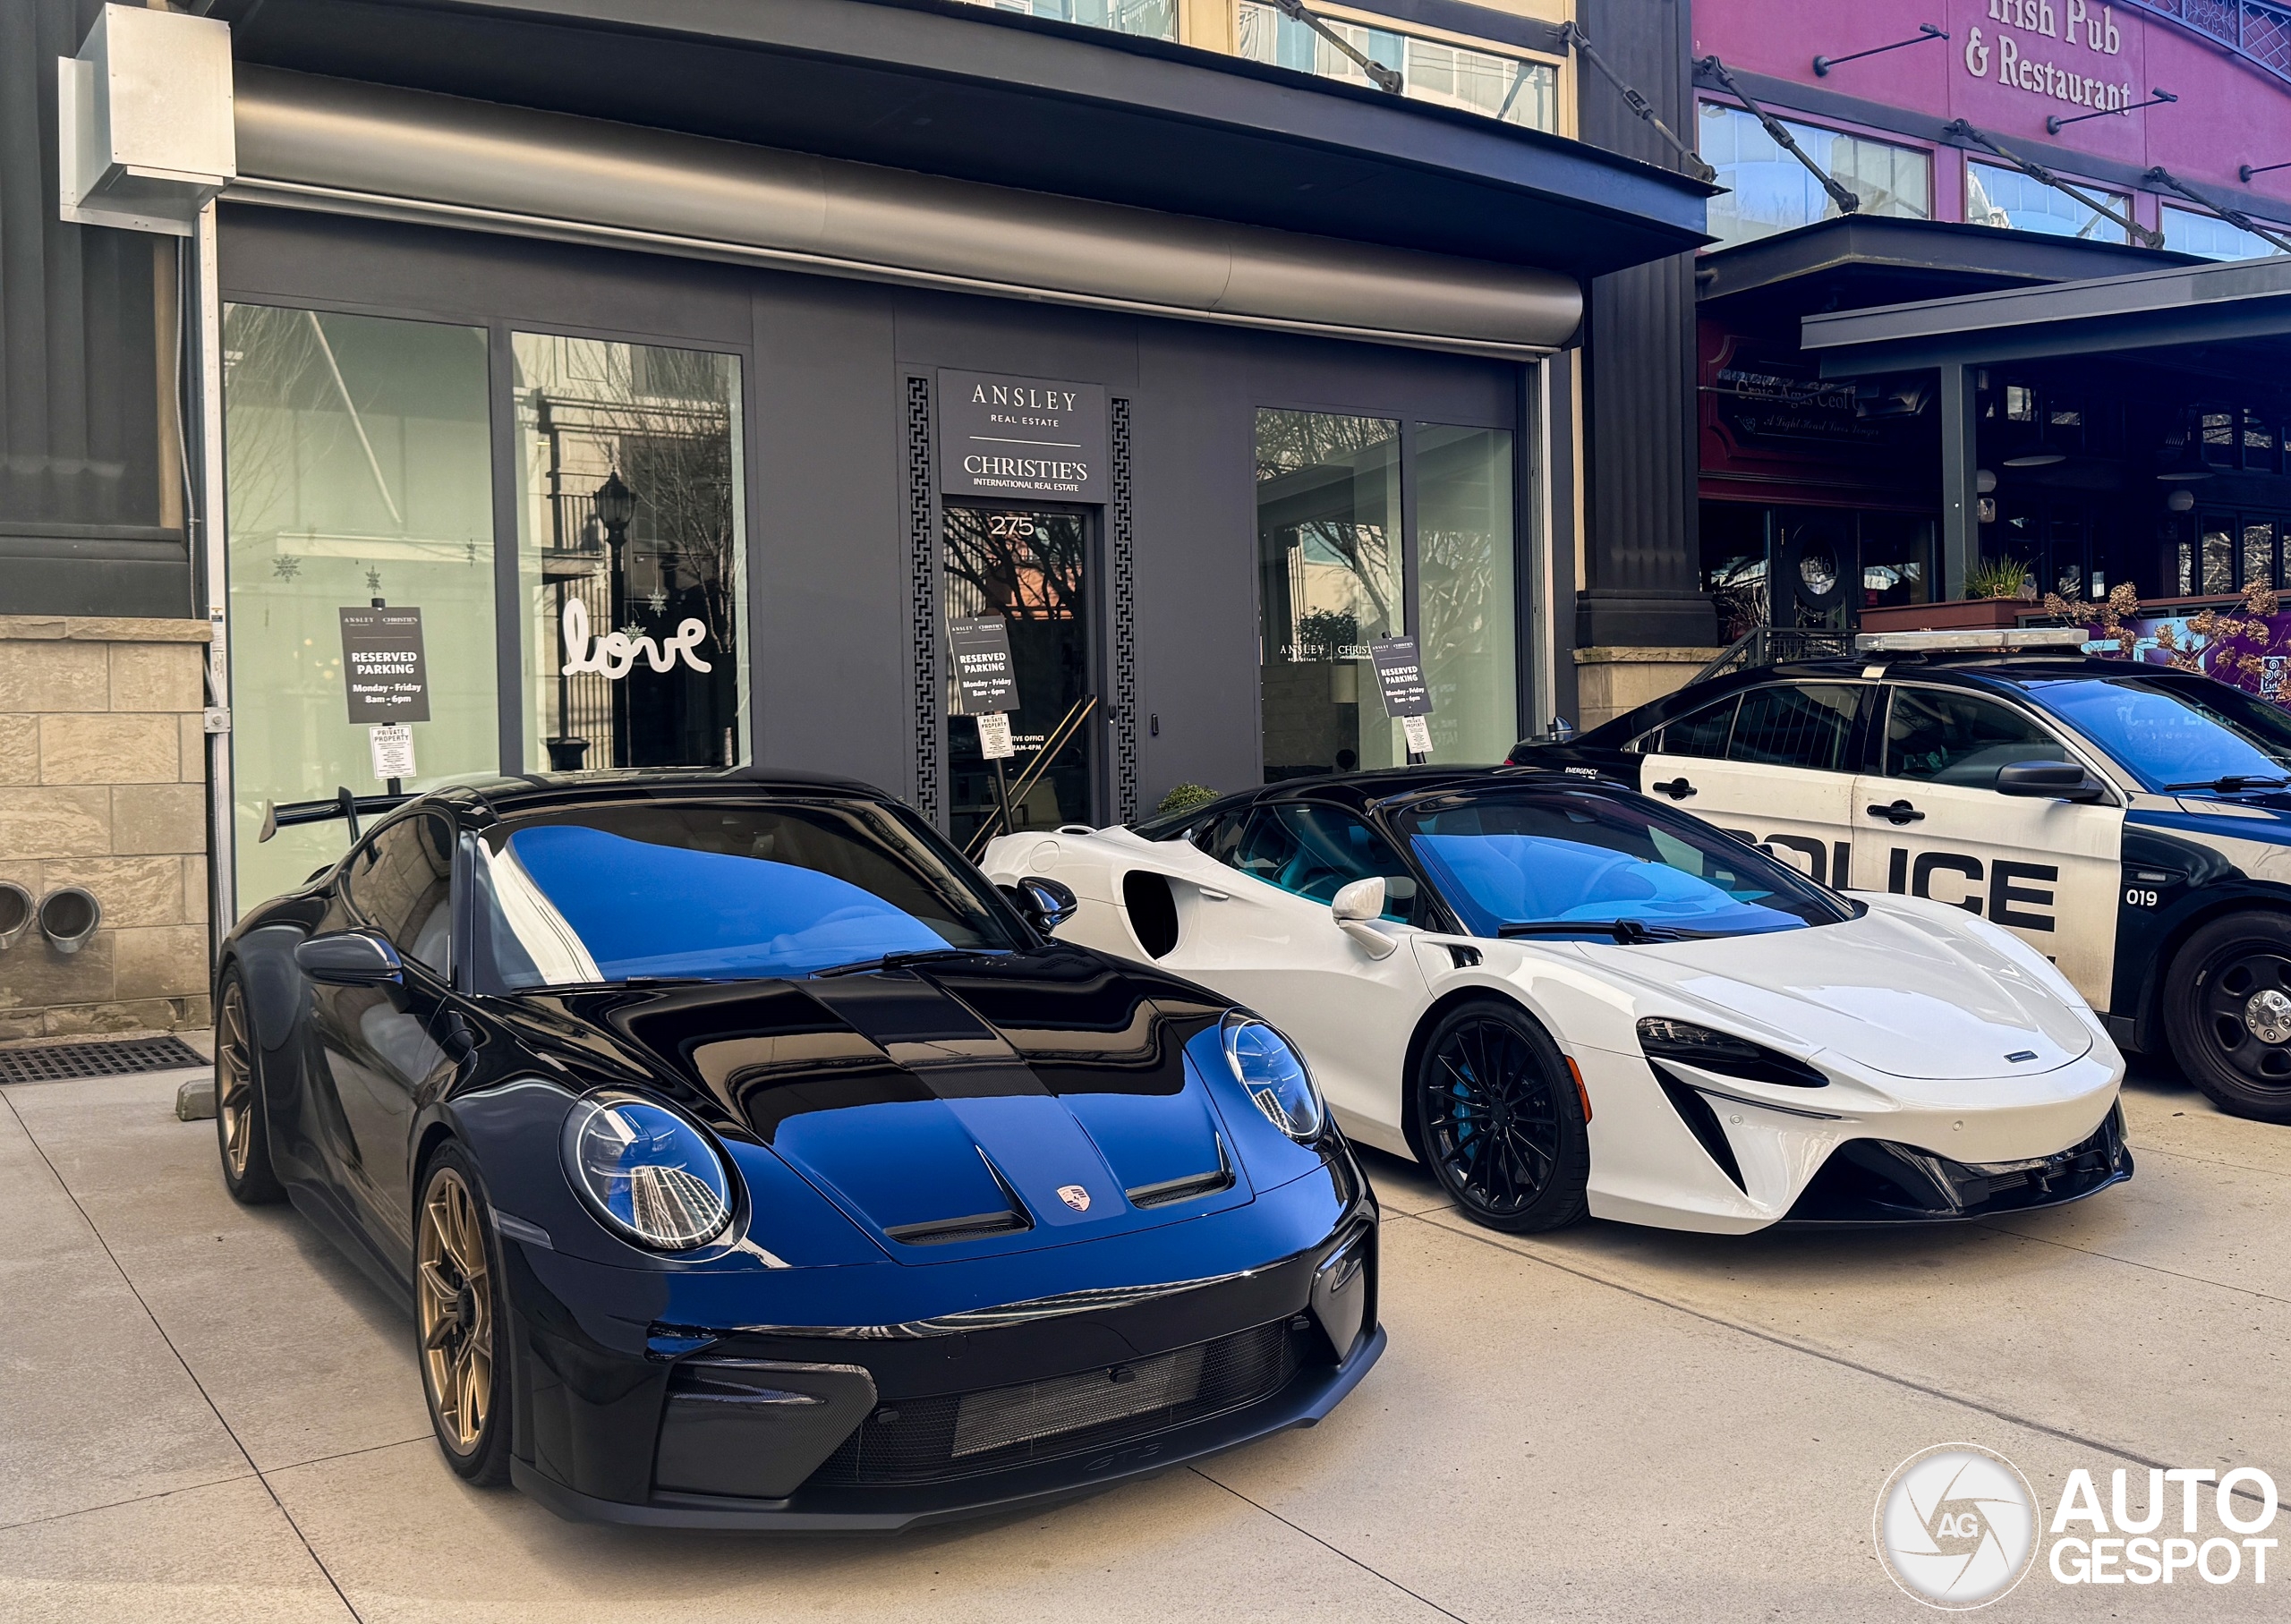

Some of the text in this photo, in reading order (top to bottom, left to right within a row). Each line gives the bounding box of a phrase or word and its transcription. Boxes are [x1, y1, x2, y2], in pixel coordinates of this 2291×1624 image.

[1989, 0, 2121, 55] Irish Pub
[1965, 26, 2131, 116] & Restaurant
[972, 383, 1077, 412] ANSLEY
[991, 414, 1060, 427] REAL ESTATE
[964, 455, 1088, 481] CHRISTIE'S
[973, 478, 1079, 492] INTERNATIONAL REAL ESTATE
[991, 515, 1035, 536] 275
[562, 598, 712, 680] love
[1280, 644, 1370, 655] ANSLEY CHRIST
[352, 651, 418, 662] RESERVED
[959, 652, 1006, 663] RESERVED
[357, 664, 414, 675] PARKING
[964, 662, 1005, 674] PARKING
[1380, 666, 1418, 676] RESERVED
[963, 680, 989, 688] Monday
[992, 677, 1011, 686] Friday
[1384, 674, 1418, 684] PARKING
[353, 684, 388, 693] Monday
[395, 683, 422, 693] Friday
[991, 688, 1006, 696] 6pm
[365, 695, 385, 703] 8am
[391, 695, 412, 704] 6pm
[1564, 766, 1598, 776] EMERGENCY
[1723, 828, 2058, 933] OLICE
[2125, 889, 2158, 906] 019
